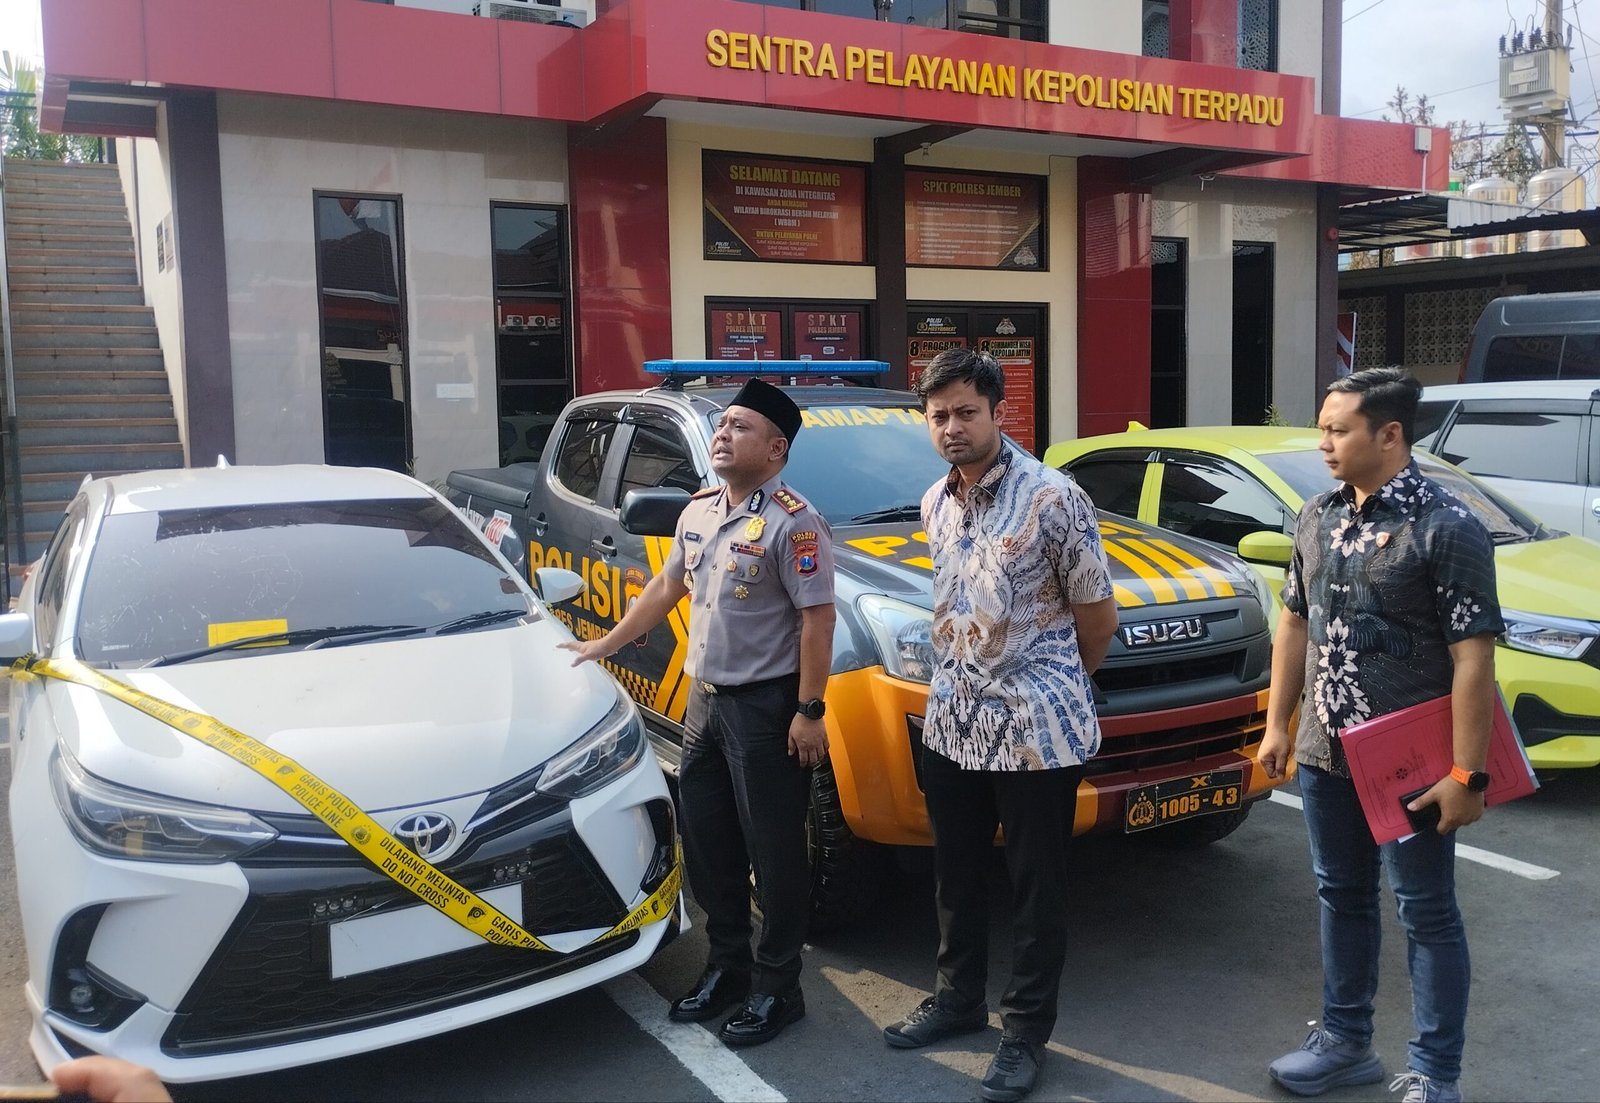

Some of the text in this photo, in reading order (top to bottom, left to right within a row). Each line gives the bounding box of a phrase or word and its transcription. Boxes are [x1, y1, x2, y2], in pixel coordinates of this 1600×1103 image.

[707, 28, 1284, 127] SENTRA PELAYANAN KEPOLISIAN TERPADU
[729, 165, 841, 187] SELAMAT DATANG
[923, 180, 1021, 197] SPKT POLRES JEMBER
[745, 186, 779, 197] KAWASAN
[798, 190, 836, 201] INTEGRITAS
[908, 340, 920, 358] 8
[799, 408, 928, 428] AMAPTA
[1124, 618, 1202, 646] ISUZU
[205, 733, 261, 766] DO NOT CROSS
[243, 739, 282, 764] MELINTAS
[290, 784, 345, 829] POLICE LINE
[299, 774, 358, 820] GARIS POLISI
[380, 836, 471, 906] DILARANG MELINTAS
[381, 857, 450, 910] DO NOT CROSS
[491, 916, 522, 941] GARIS
[621, 906, 650, 932] MELINTAS
